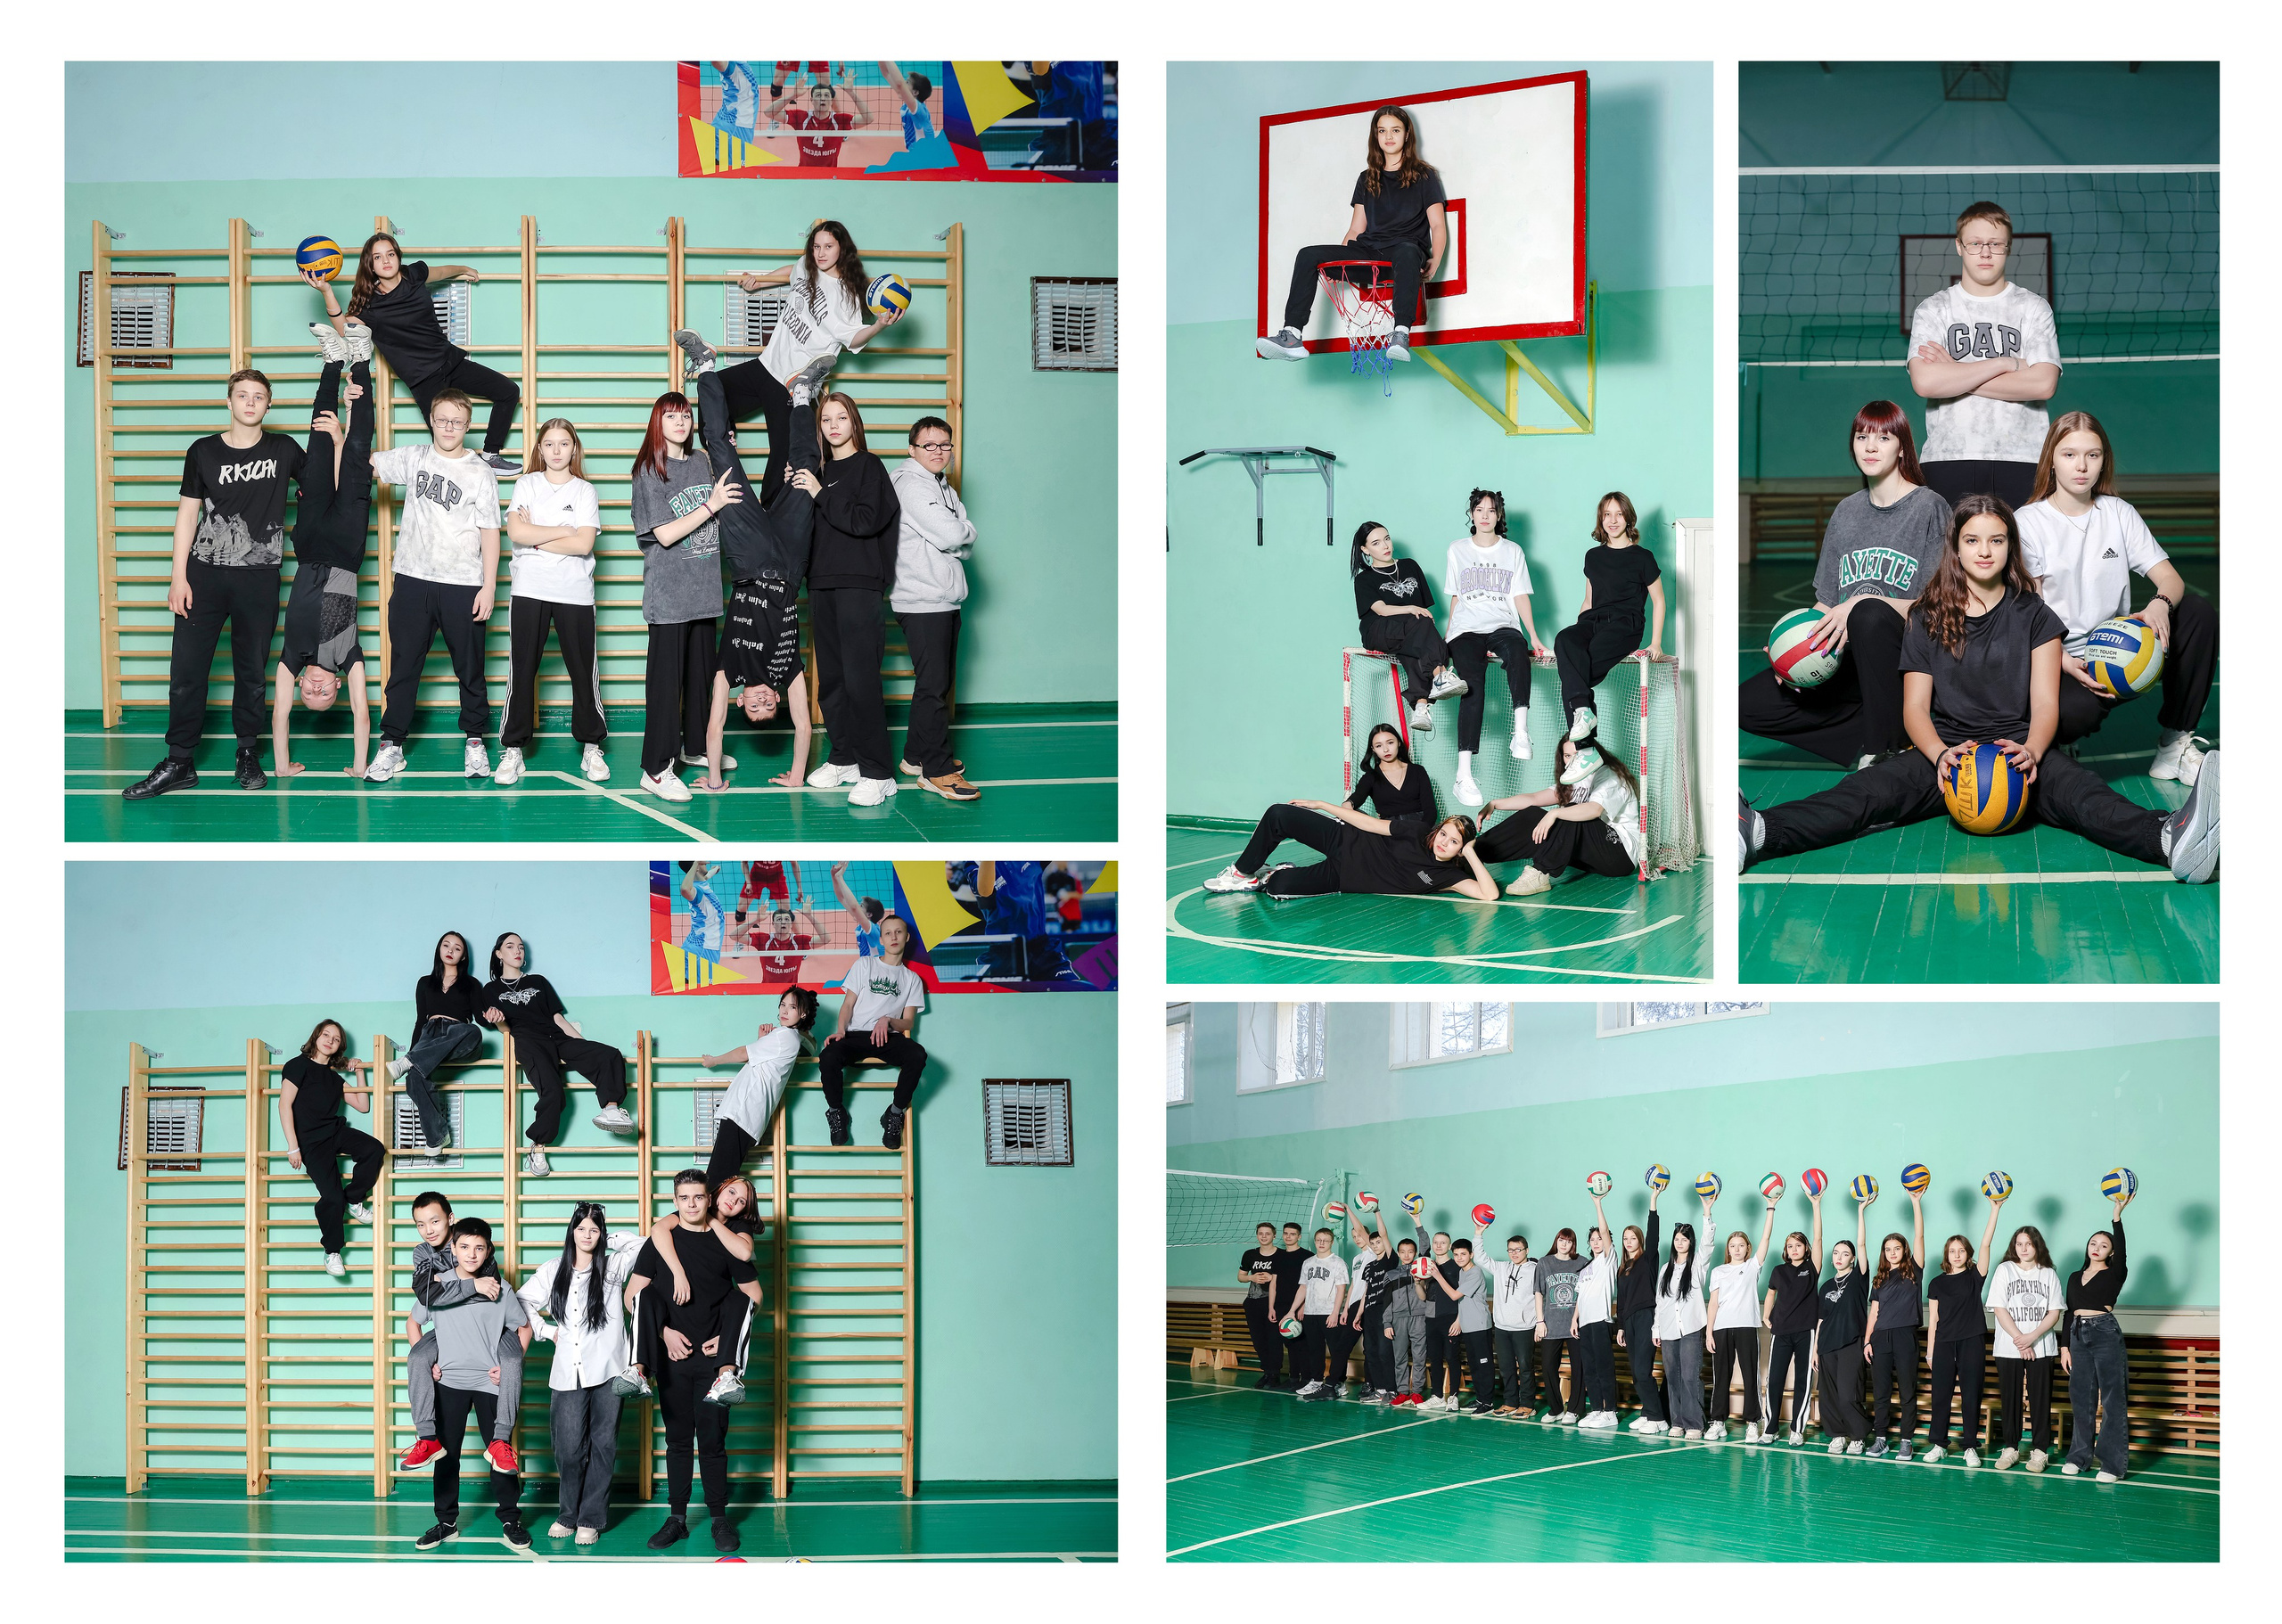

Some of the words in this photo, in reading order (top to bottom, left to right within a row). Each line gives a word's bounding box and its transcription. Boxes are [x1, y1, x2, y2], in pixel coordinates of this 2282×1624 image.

[803, 146, 821, 157] ЗВЕЗДА
[1948, 323, 2021, 360] GAP
[415, 470, 462, 512] GAP
[669, 484, 713, 518] FAYET
[1460, 567, 1514, 595] BROOKLYN
[1839, 547, 1918, 591] AYETTE
[766, 964, 783, 974] ЗВЕЗДА
[1308, 1267, 1330, 1281] GAP
